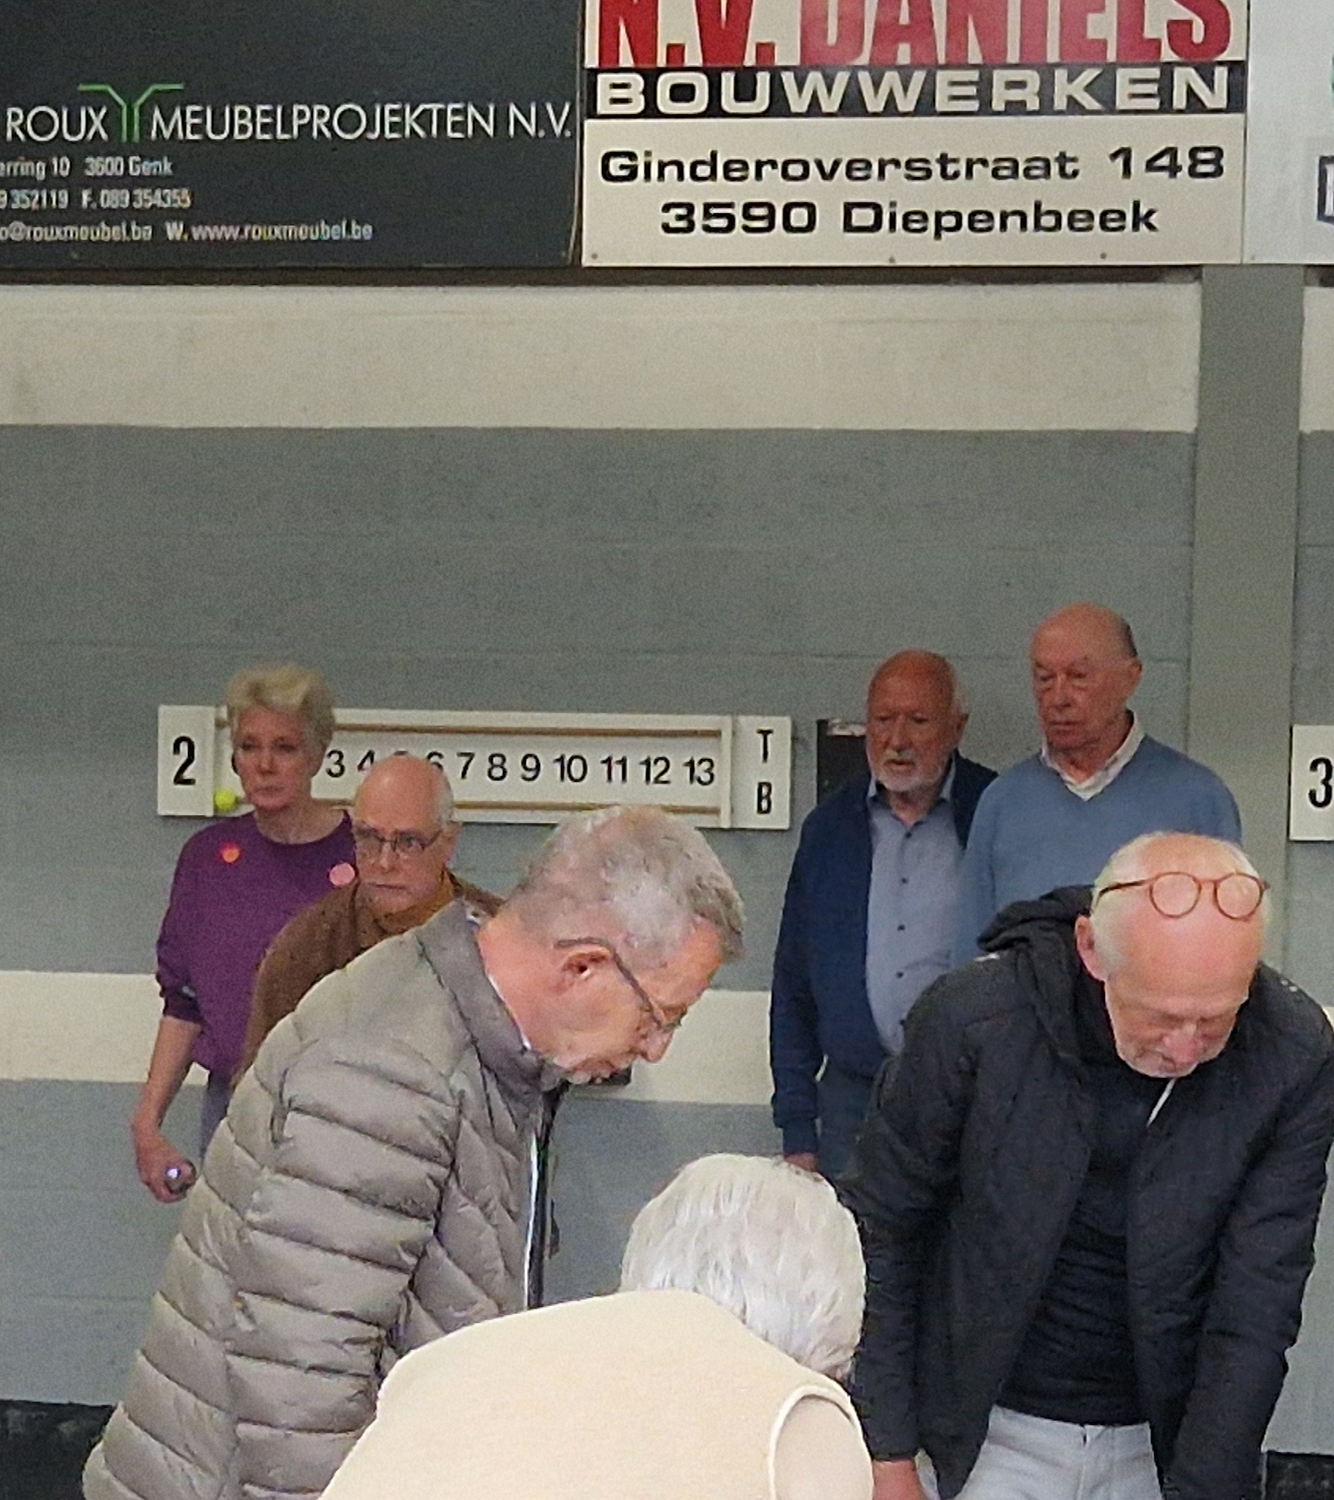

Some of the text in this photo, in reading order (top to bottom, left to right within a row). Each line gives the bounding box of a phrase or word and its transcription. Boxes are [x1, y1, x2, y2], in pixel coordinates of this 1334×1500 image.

[798, 0, 1232, 66] DANIELS
[596, 64, 1229, 115] BOUWWERKEN
[6, 105, 108, 142] ROUX
[151, 101, 495, 141] MEUBELPROJEKTEN
[508, 101, 573, 140] N.V.
[51, 156, 70, 176] 10
[84, 156, 125, 177] 3600
[129, 156, 173, 177] Genk
[600, 146, 1225, 184] Ginderoverstraat 148
[660, 199, 1159, 239] 3590 Diepenbeek
[172, 736, 196, 785] 2
[756, 728, 774, 763] T
[325, 750, 346, 778] 3
[456, 752, 475, 779] 7
[487, 753, 508, 782] 8
[521, 753, 541, 782] 9
[554, 754, 588, 783] 10
[600, 756, 628, 783] 11
[640, 756, 671, 785] 12
[683, 757, 715, 786] 13
[1308, 757, 1334, 808] 3
[756, 782, 772, 815] B
